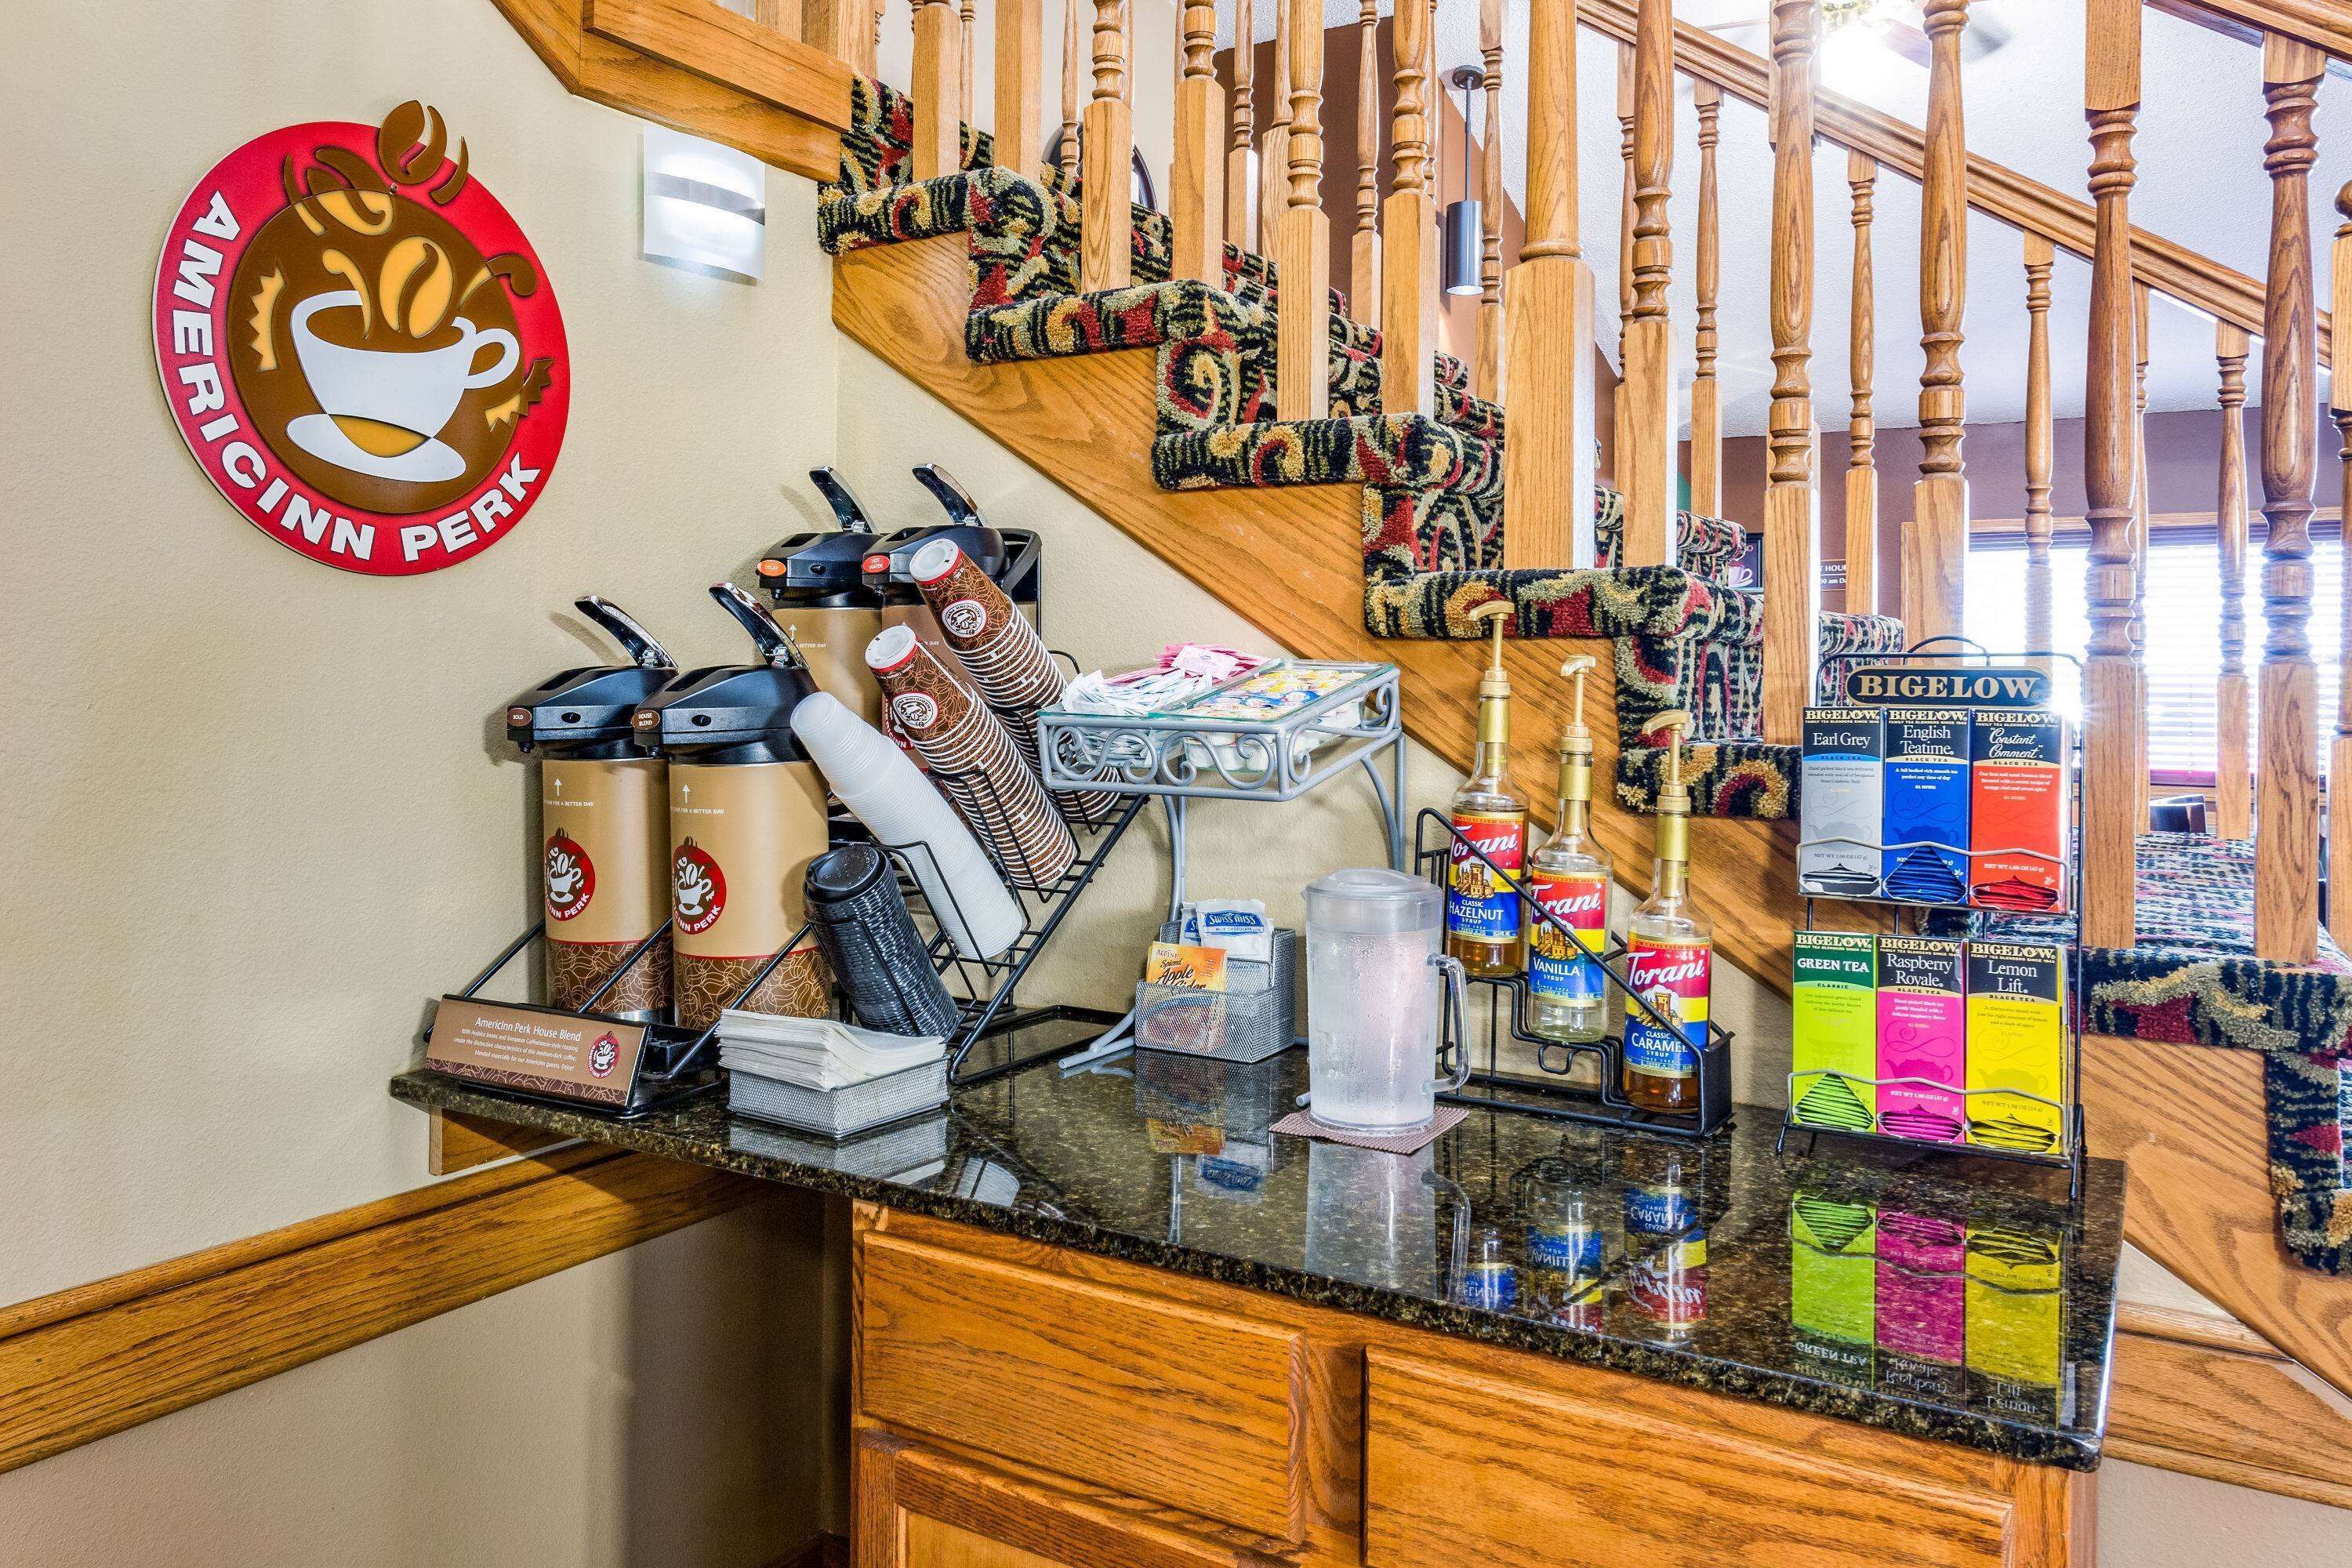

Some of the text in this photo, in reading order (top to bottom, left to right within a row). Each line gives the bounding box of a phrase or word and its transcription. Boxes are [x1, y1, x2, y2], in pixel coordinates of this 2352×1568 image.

[172, 190, 542, 562] AMERICINN PERK
[1857, 675, 2040, 699] BIGELOW
[1805, 710, 1879, 720] BIGELOW
[1888, 710, 1967, 720] BIGELOW
[1976, 712, 2058, 724] BIGELOW
[1813, 732, 1871, 748] Earl Grey
[1903, 724, 1951, 741] English
[1900, 740, 1951, 755] Teatime
[564, 892, 590, 918] PERK
[1449, 900, 1504, 920] HAZELNUT
[1461, 899, 1484, 908] CLASSIC
[693, 904, 721, 931] PERK
[1795, 935, 1872, 948] BIGELOW
[1880, 938, 1958, 953] BIGELOW
[1970, 943, 2056, 959] BIGELOW
[1160, 957, 1184, 969] Spiced
[1533, 956, 1581, 977] VANILLA
[1627, 949, 1706, 987] Torani
[1797, 958, 1870, 973] GREEN TEA
[1886, 953, 1953, 974] Raspberry
[1987, 960, 2038, 978] Lemon
[1156, 964, 1194, 985] Apple
[1896, 970, 1940, 987] Royale
[1997, 977, 2023, 993] Lift
[514, 1022, 531, 1034] Perk
[533, 1025, 557, 1038] House
[559, 1029, 582, 1042] Blend
[1646, 1030, 1671, 1040] CLASSIC
[1632, 1033, 1688, 1053] CARAMEL
